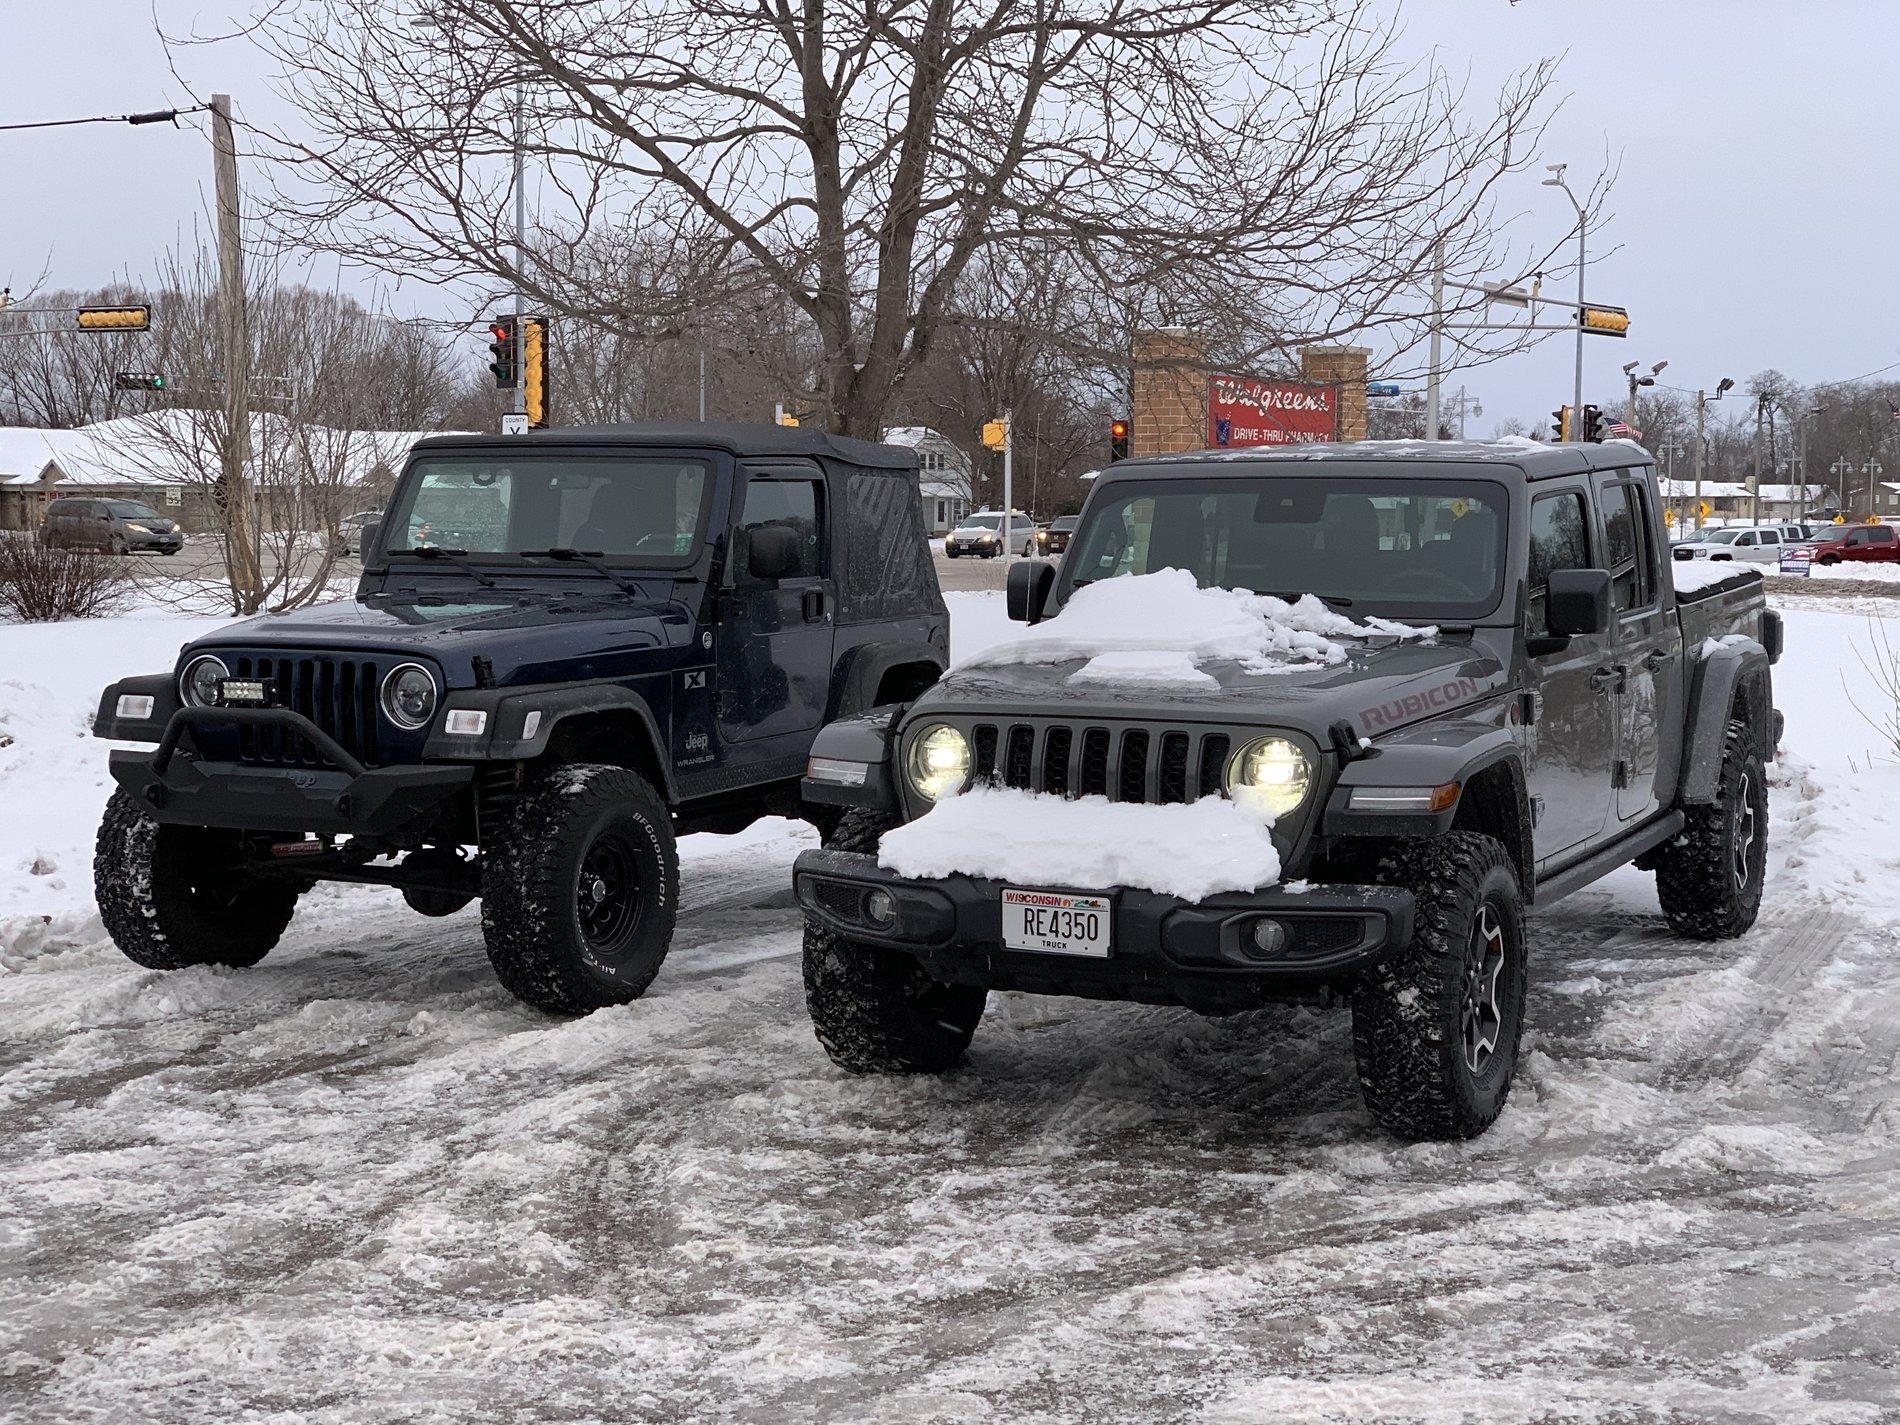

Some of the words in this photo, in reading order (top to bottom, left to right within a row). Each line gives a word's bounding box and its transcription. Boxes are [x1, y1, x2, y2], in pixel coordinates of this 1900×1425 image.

[1215, 380, 1330, 416] Walgreens
[1359, 677, 1479, 731] RUBICON
[685, 732, 708, 750] Jeep
[677, 754, 715, 767] WRANGLER
[632, 812, 667, 908] BFGoodrich
[1006, 892, 1061, 906] WISCONSIN
[1023, 908, 1098, 941] RE4350
[1042, 940, 1067, 949] TRUCK
